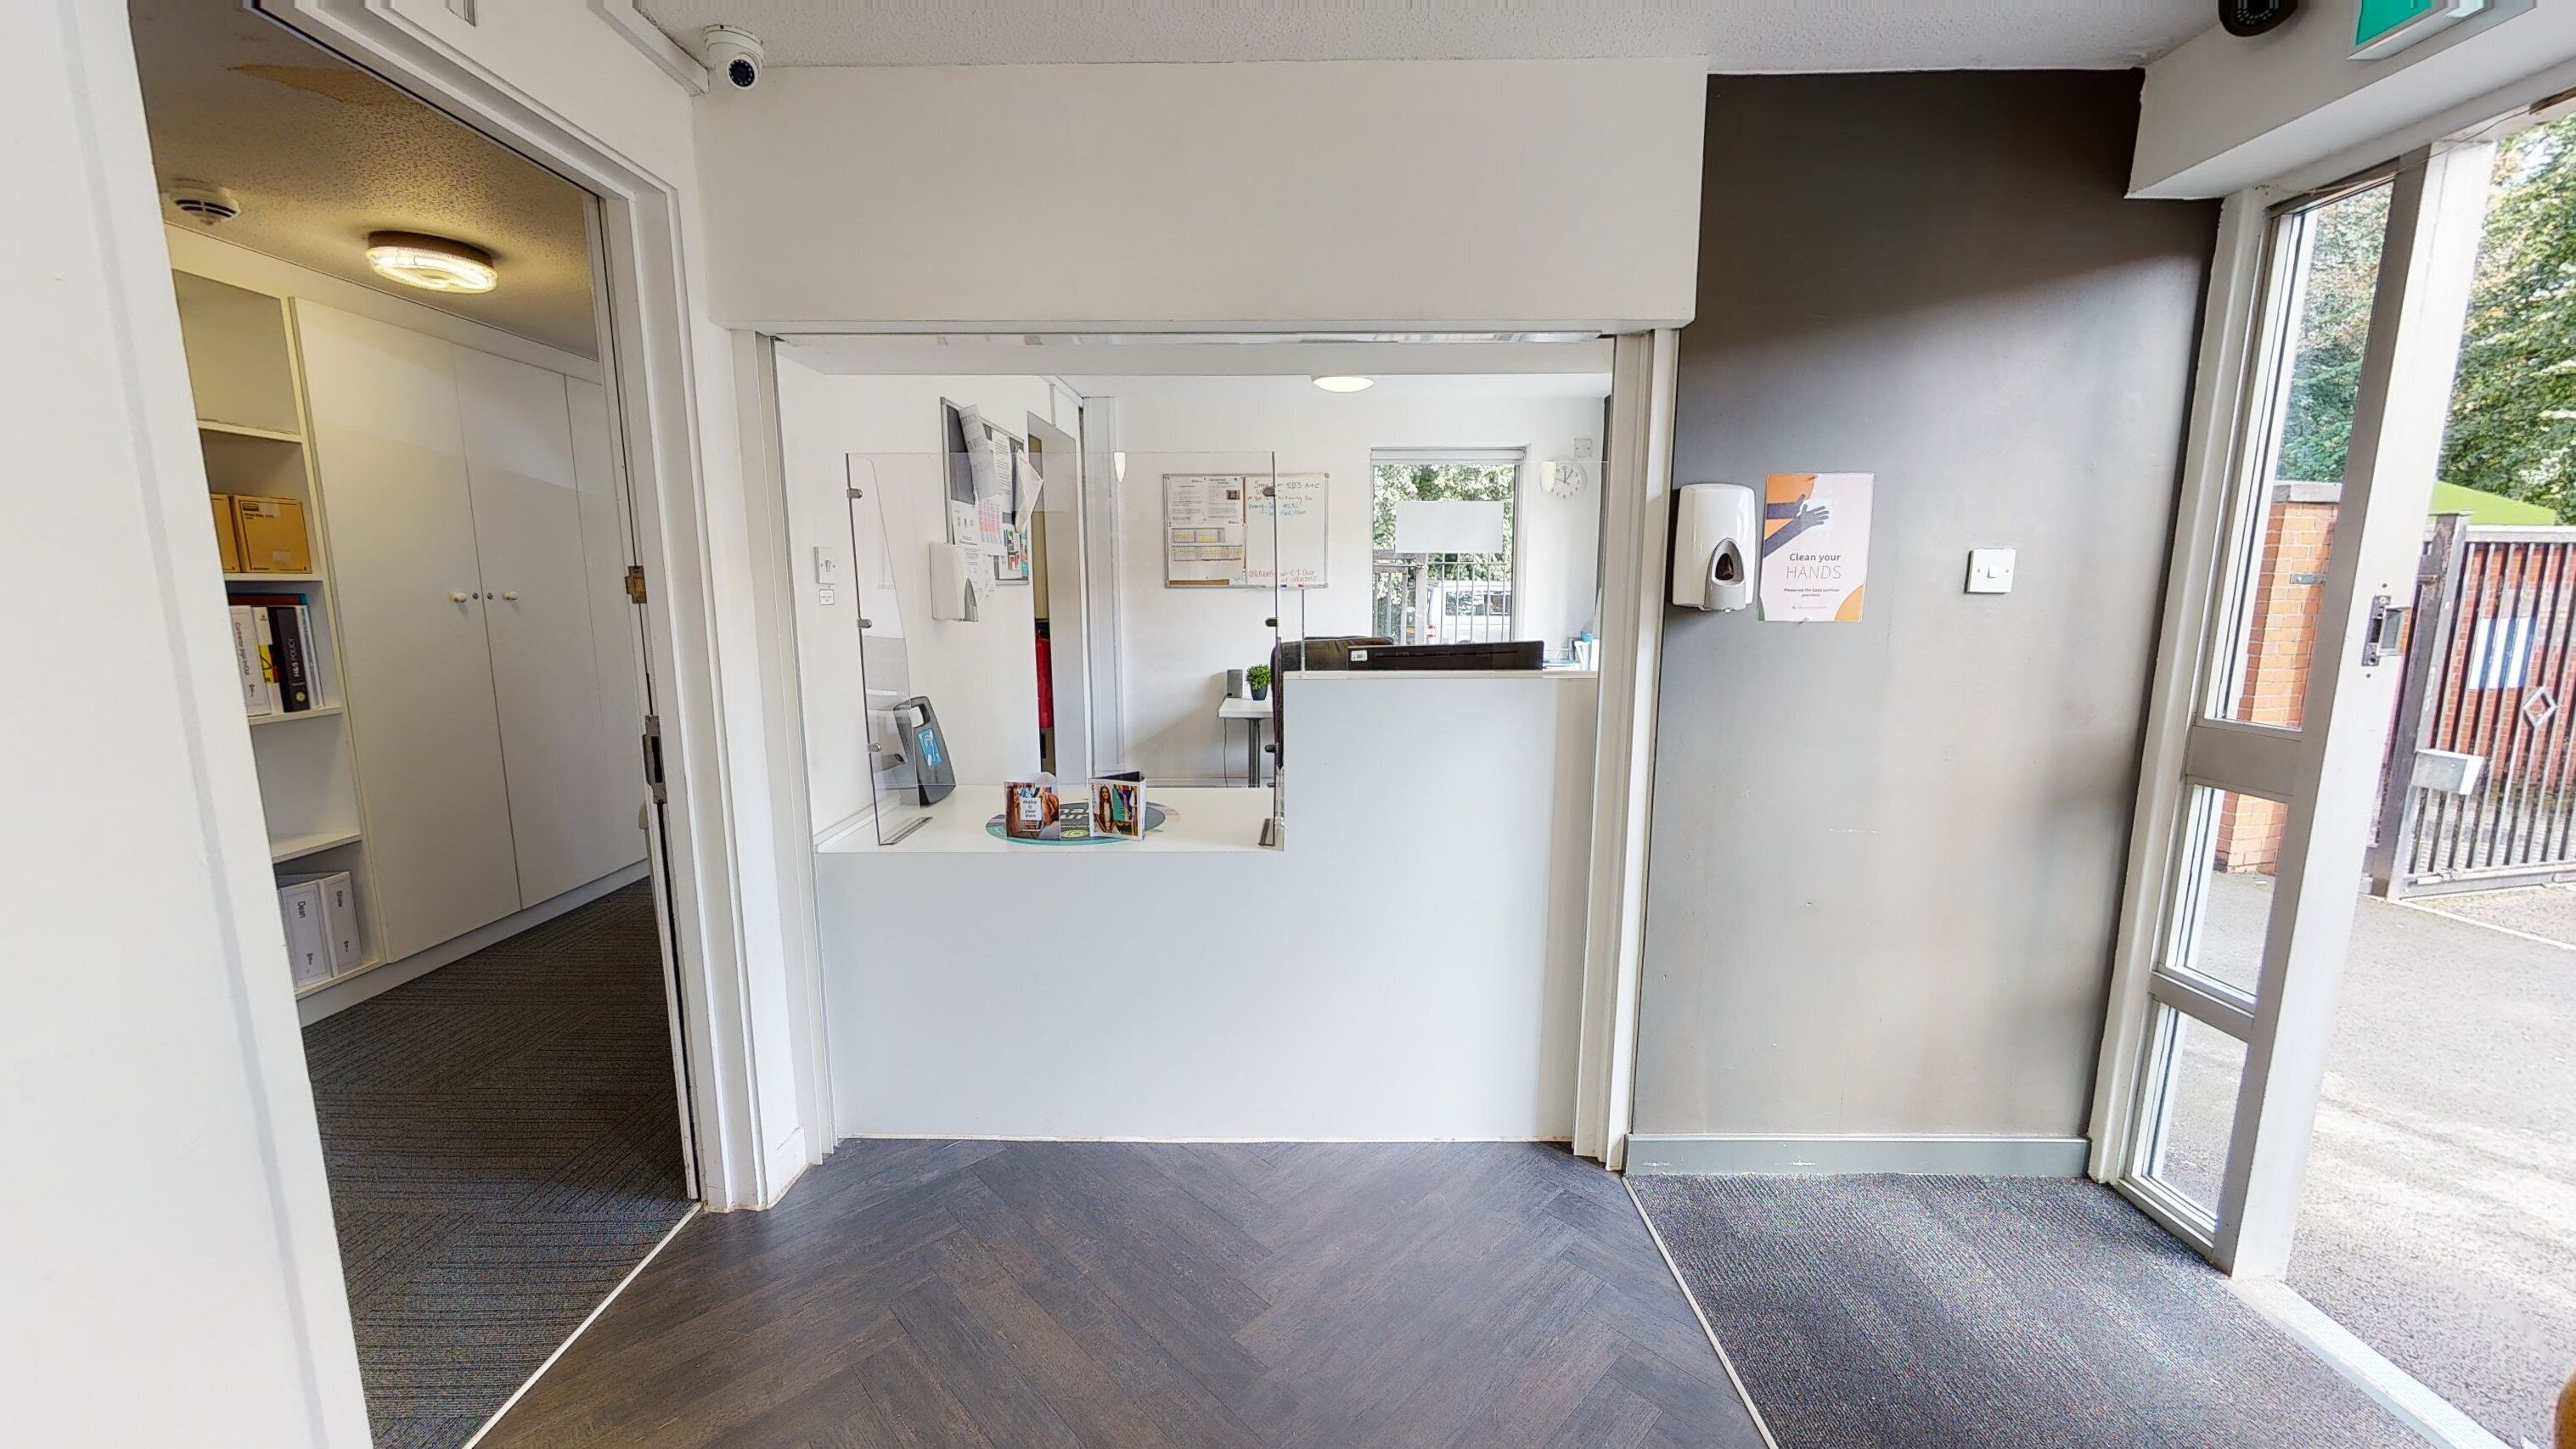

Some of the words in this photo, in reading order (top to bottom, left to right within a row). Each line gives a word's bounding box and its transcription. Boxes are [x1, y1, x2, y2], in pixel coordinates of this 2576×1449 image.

[1789, 553, 1817, 561] Clean
[1818, 554, 1842, 564] your
[1786, 565, 1842, 580] HANDS
